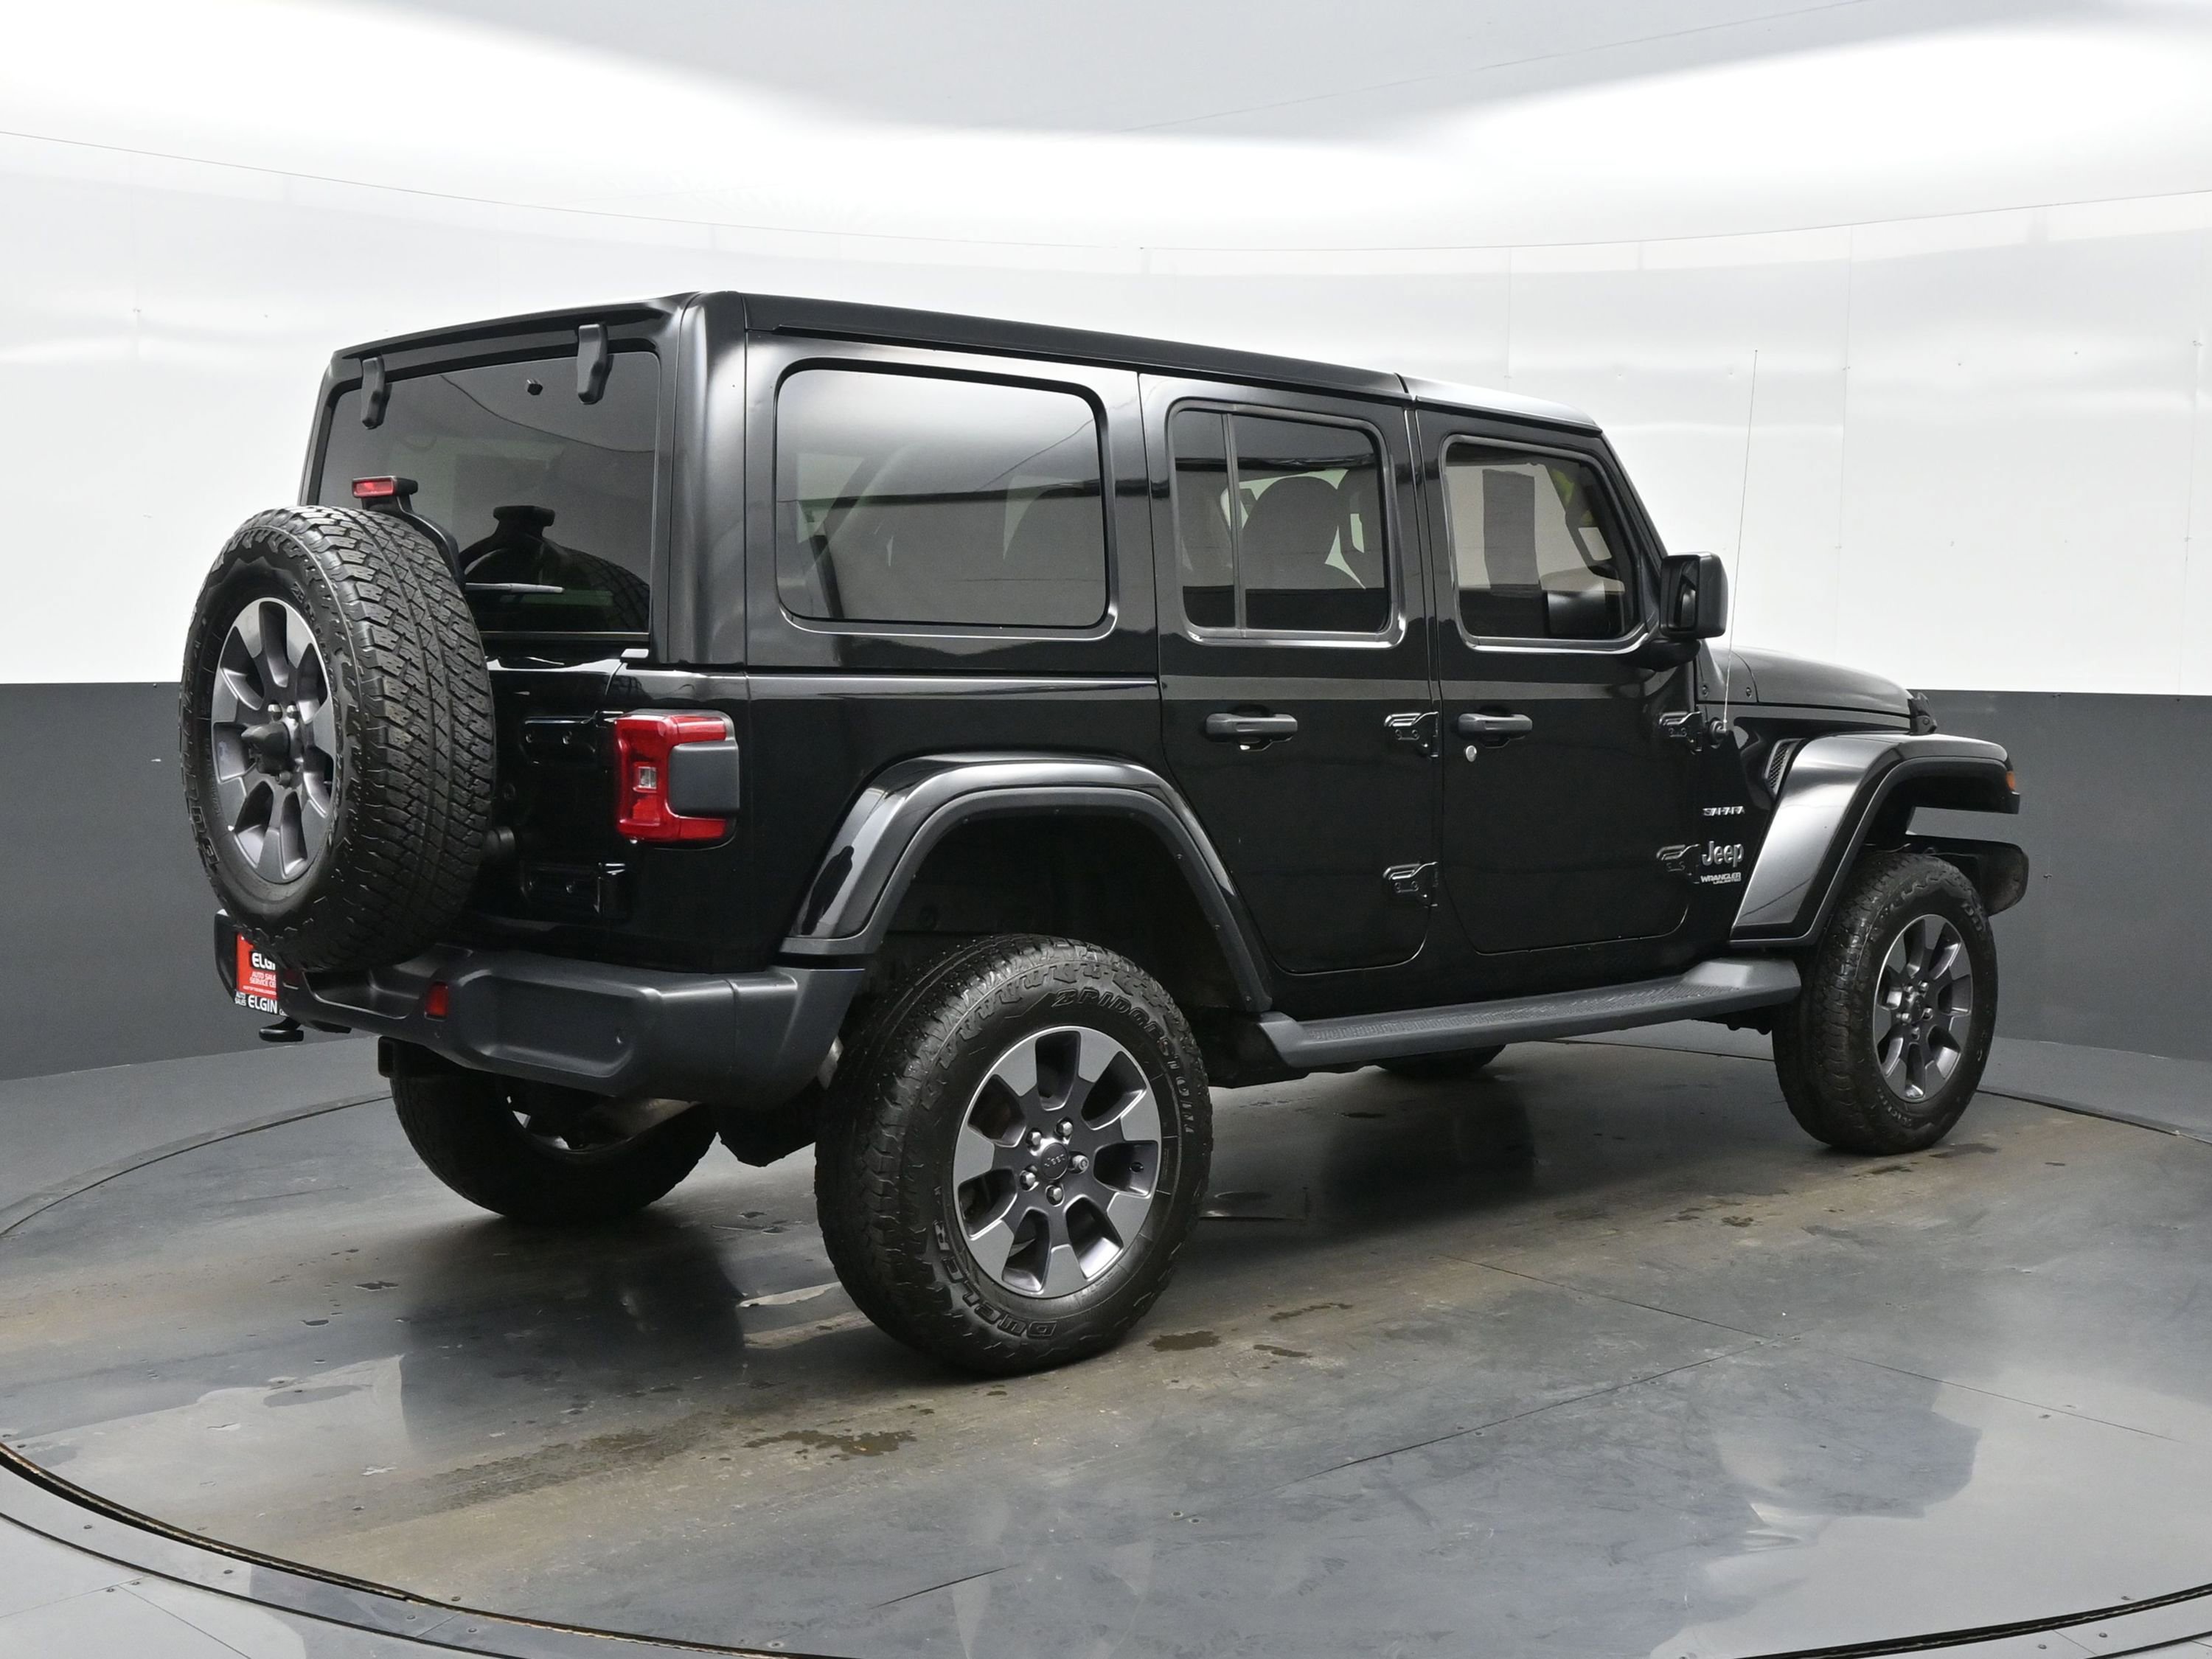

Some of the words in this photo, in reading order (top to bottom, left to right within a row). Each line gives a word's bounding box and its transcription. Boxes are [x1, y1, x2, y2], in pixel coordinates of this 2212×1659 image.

[1701, 841, 1745, 868] Jeep
[1700, 872, 1741, 883] WRANGLER
[251, 971, 264, 979] AUTO
[234, 997, 247, 1006] SALES
[248, 995, 278, 1014] ELGIN
